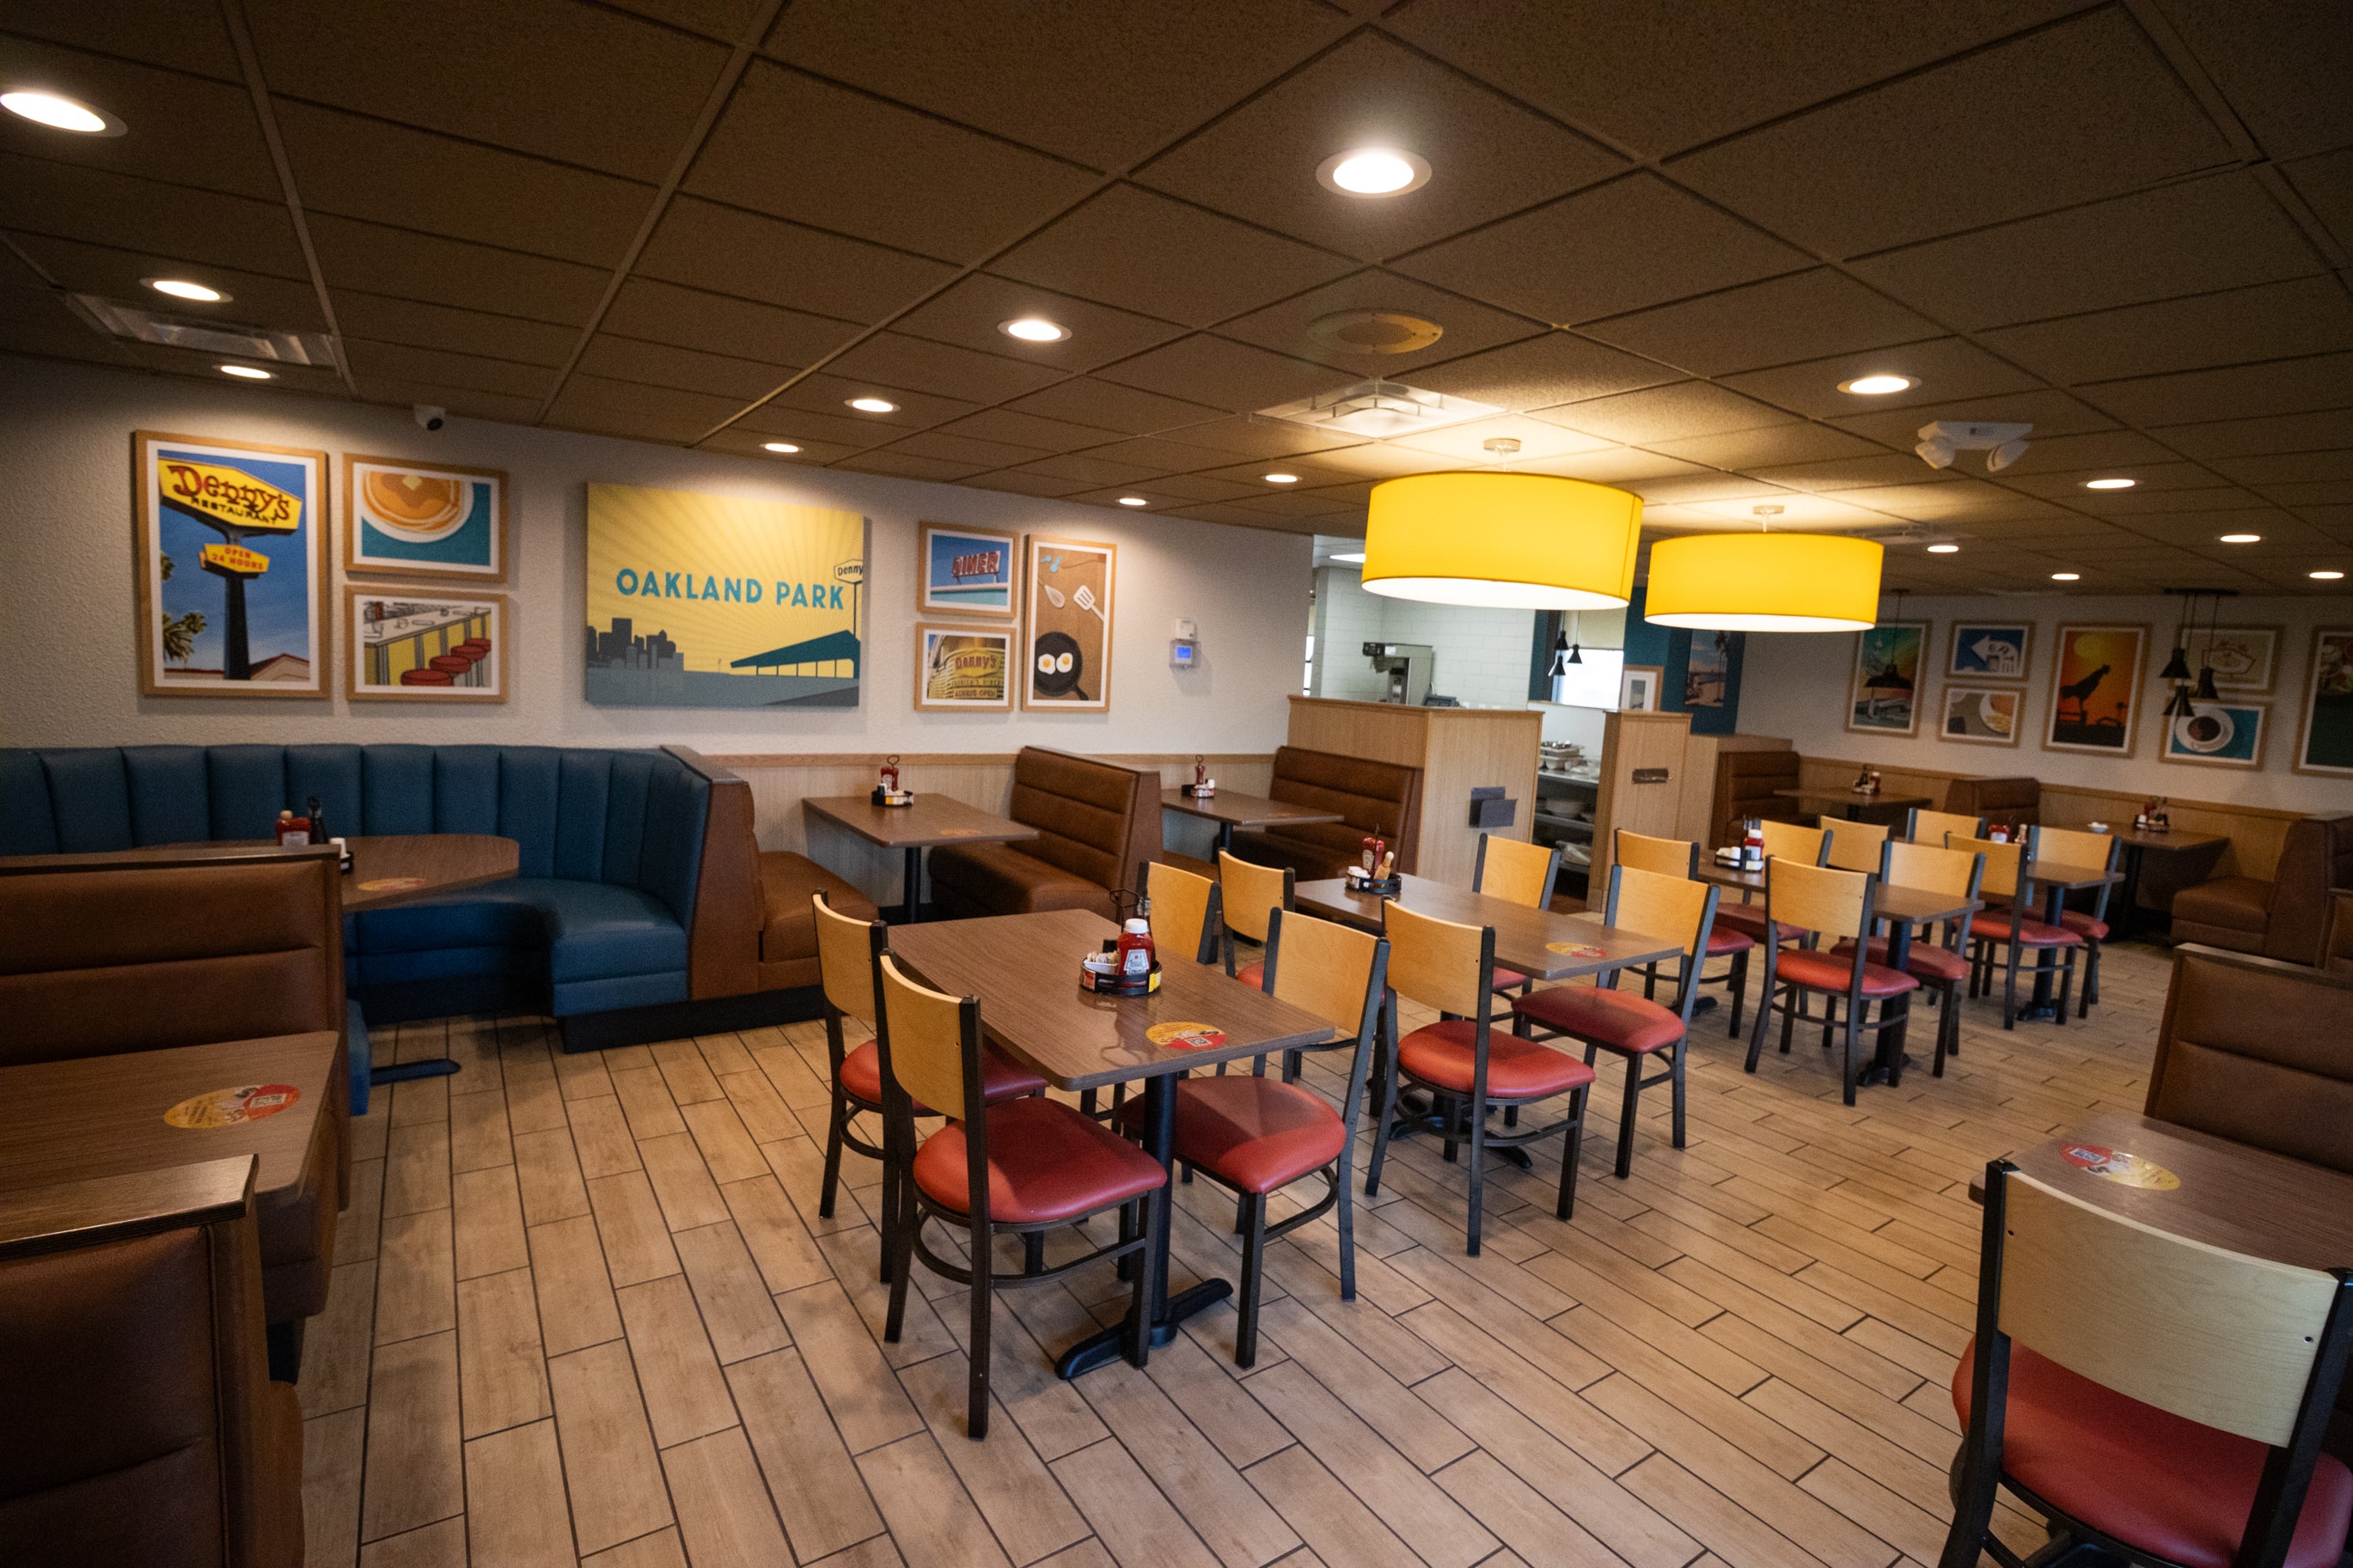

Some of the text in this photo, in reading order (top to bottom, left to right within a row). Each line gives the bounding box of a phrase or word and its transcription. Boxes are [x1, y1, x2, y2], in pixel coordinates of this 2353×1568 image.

[167, 465, 290, 521] Denny's
[191, 497, 277, 525] RESTAURANT
[224, 547, 252, 559] OPEN
[229, 558, 263, 570] HOURS
[952, 552, 998, 577] DINER
[616, 568, 844, 610] OAKLAND PARK
